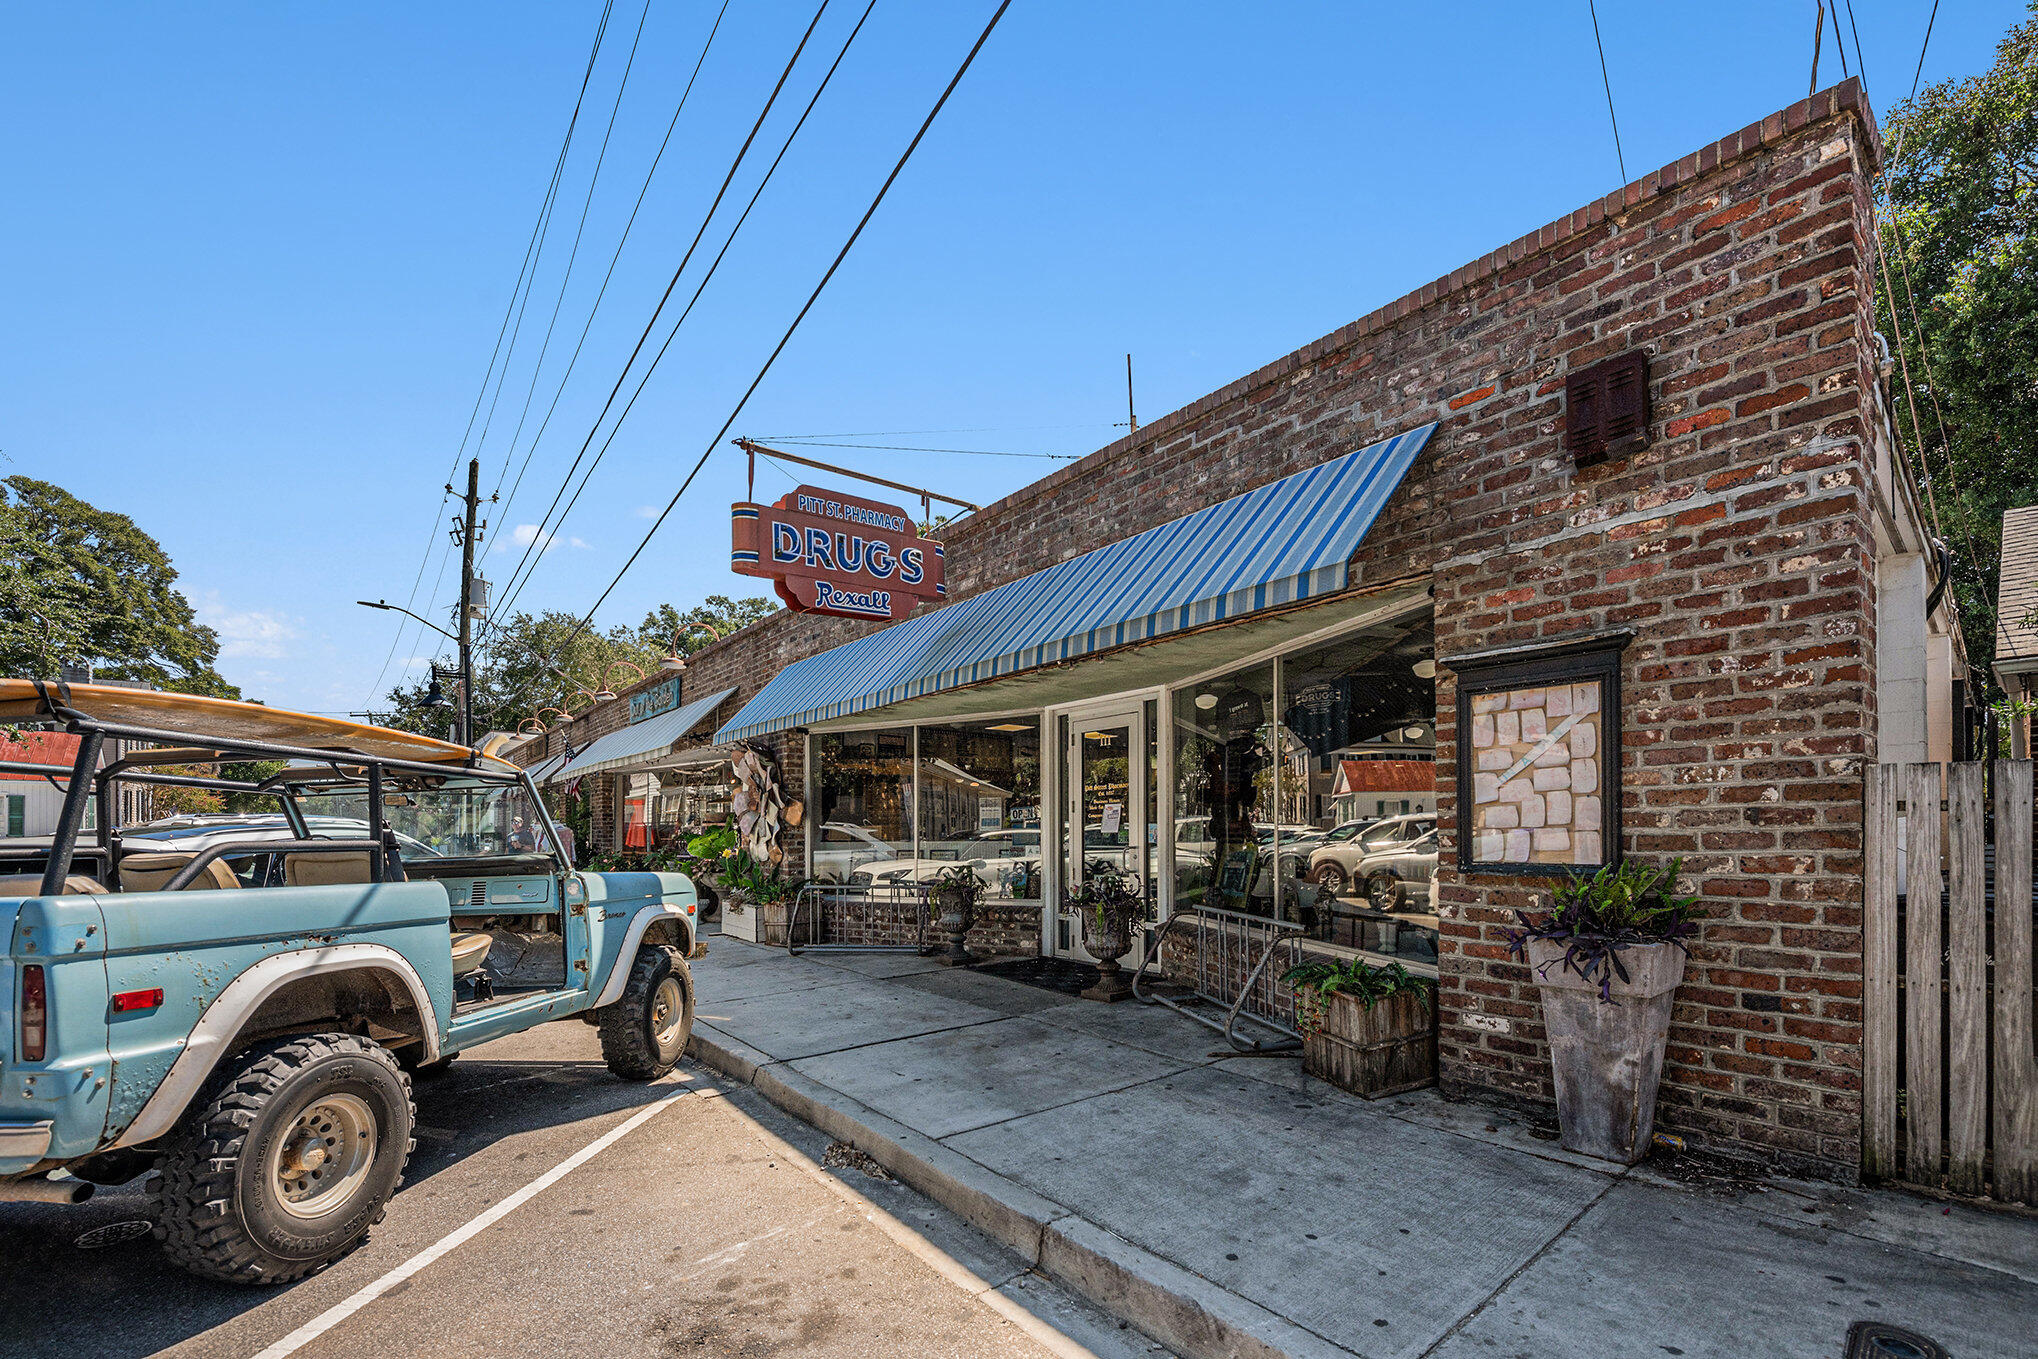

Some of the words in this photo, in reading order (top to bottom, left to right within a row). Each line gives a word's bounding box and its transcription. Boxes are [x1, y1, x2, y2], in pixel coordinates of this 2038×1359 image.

[798, 494, 824, 514] PITT
[826, 501, 843, 519] ST.
[844, 504, 905, 532] PHARMACY
[772, 521, 923, 585] DRUGS
[815, 580, 891, 615] Rexall
[1302, 691, 1335, 702] DRUGS
[597, 909, 626, 922] Bronco
